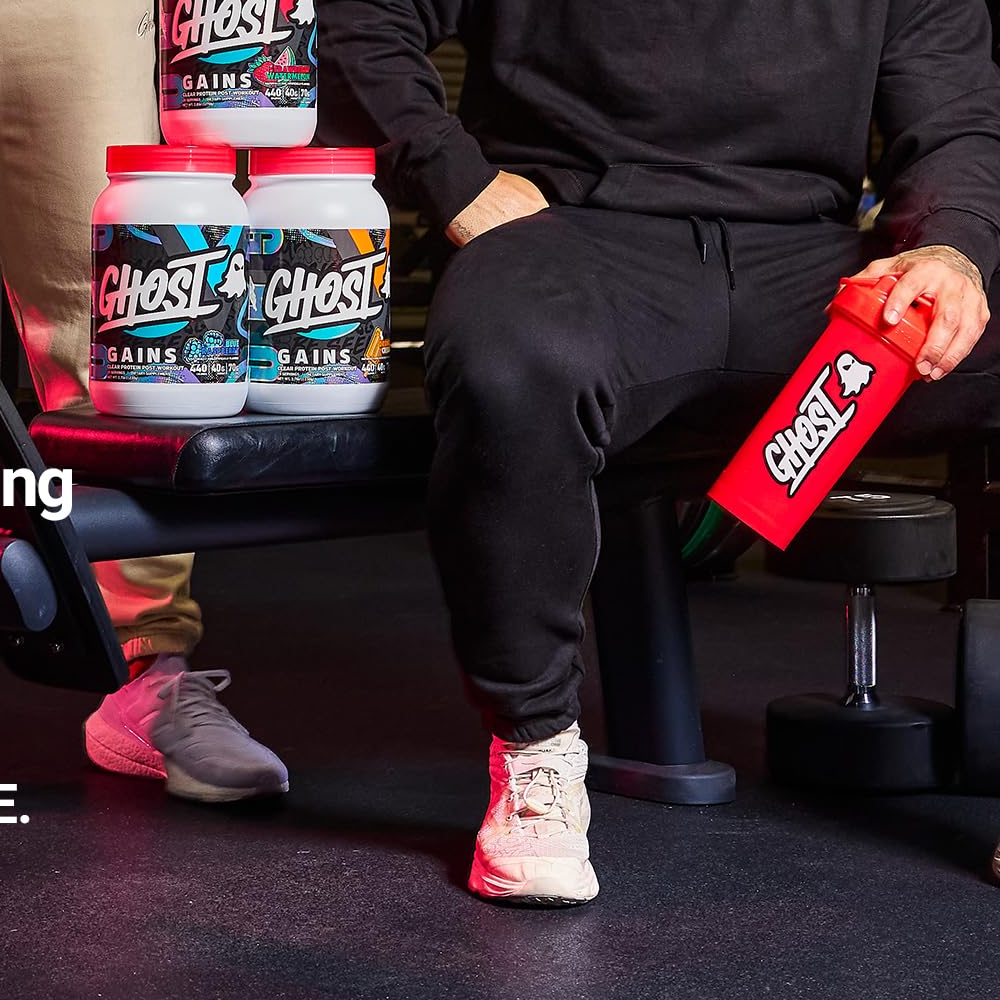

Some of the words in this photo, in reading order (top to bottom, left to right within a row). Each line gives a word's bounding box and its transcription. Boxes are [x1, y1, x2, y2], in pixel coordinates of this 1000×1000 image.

[182, 73, 252, 90] GAINS
[97, 249, 229, 333] GHOST
[263, 251, 386, 336] GHOST
[108, 347, 177, 363] GAINS
[277, 349, 351, 364] GAINS
[765, 364, 856, 497] GHOST
